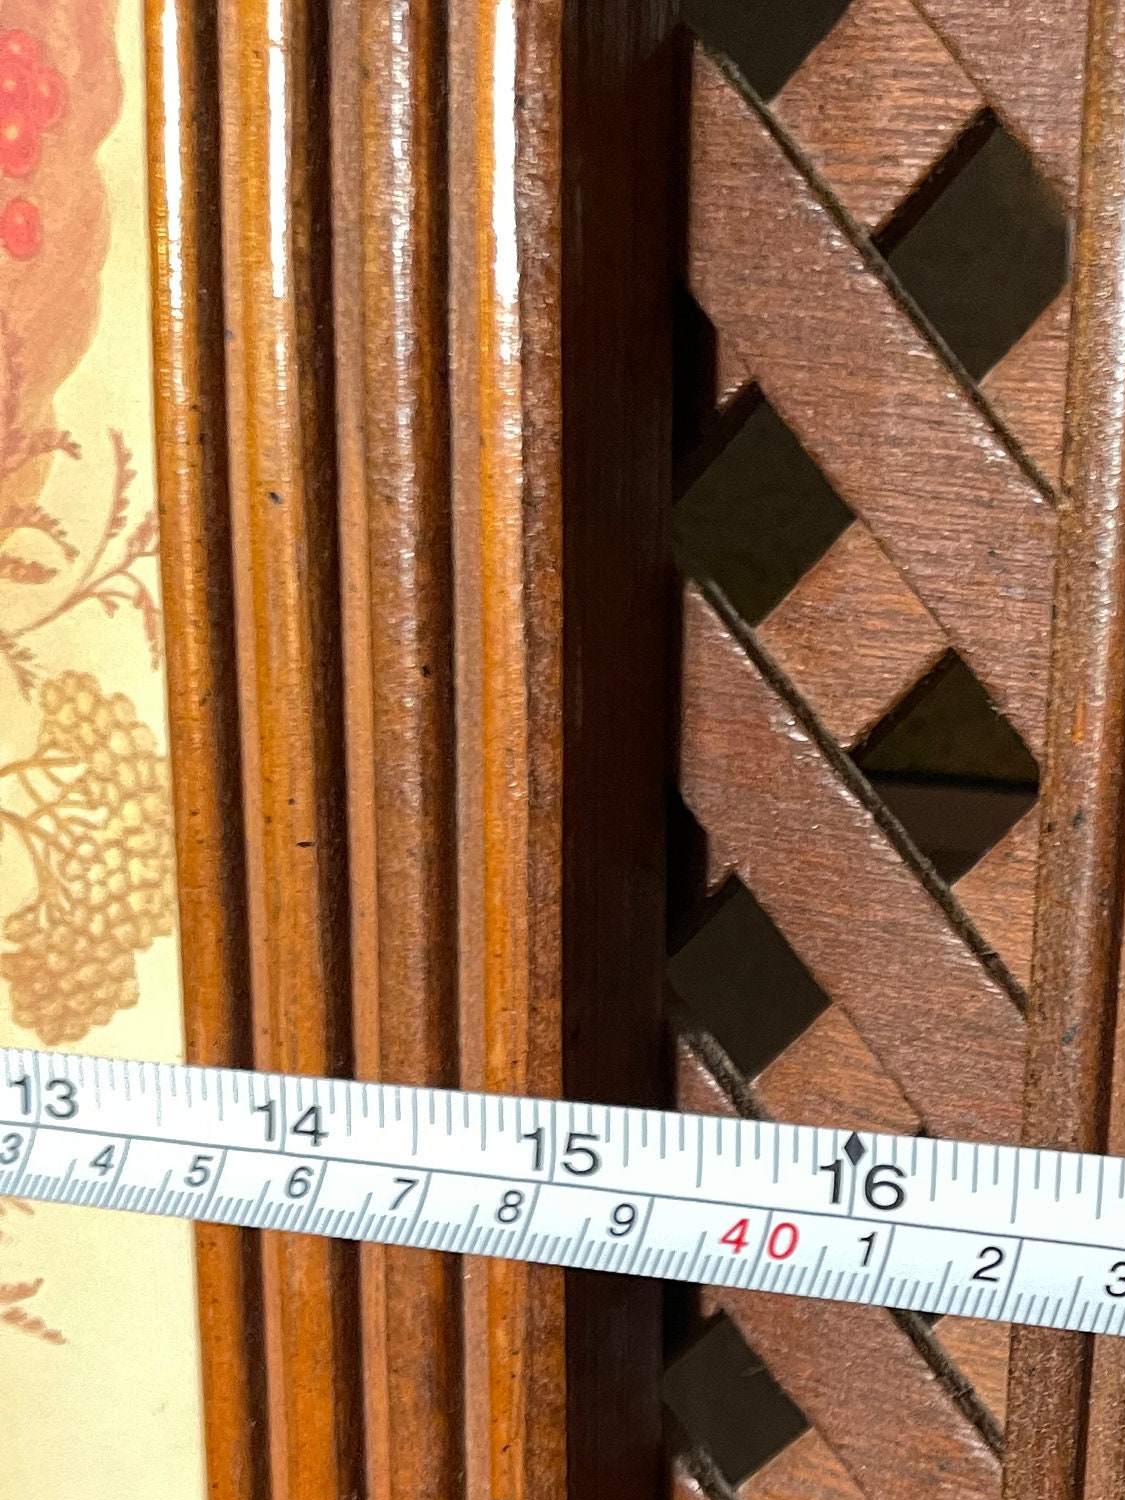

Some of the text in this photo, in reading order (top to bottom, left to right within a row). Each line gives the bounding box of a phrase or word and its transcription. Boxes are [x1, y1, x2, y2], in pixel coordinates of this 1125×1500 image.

[0, 1132, 22, 1166] 3
[89, 1143, 116, 1177] 4
[184, 1153, 213, 1188] 5
[284, 1165, 314, 1201] 6
[390, 1177, 419, 1212] 7
[496, 1188, 525, 1225] 8
[607, 1201, 637, 1238] 9
[720, 1216, 800, 1262] 40
[858, 1232, 877, 1268] 1
[972, 1245, 1005, 1284] 2
[8, 1073, 78, 1120] 13
[255, 1099, 328, 1148] 14
[522, 1127, 603, 1177] 15
[819, 1158, 907, 1211] 16
